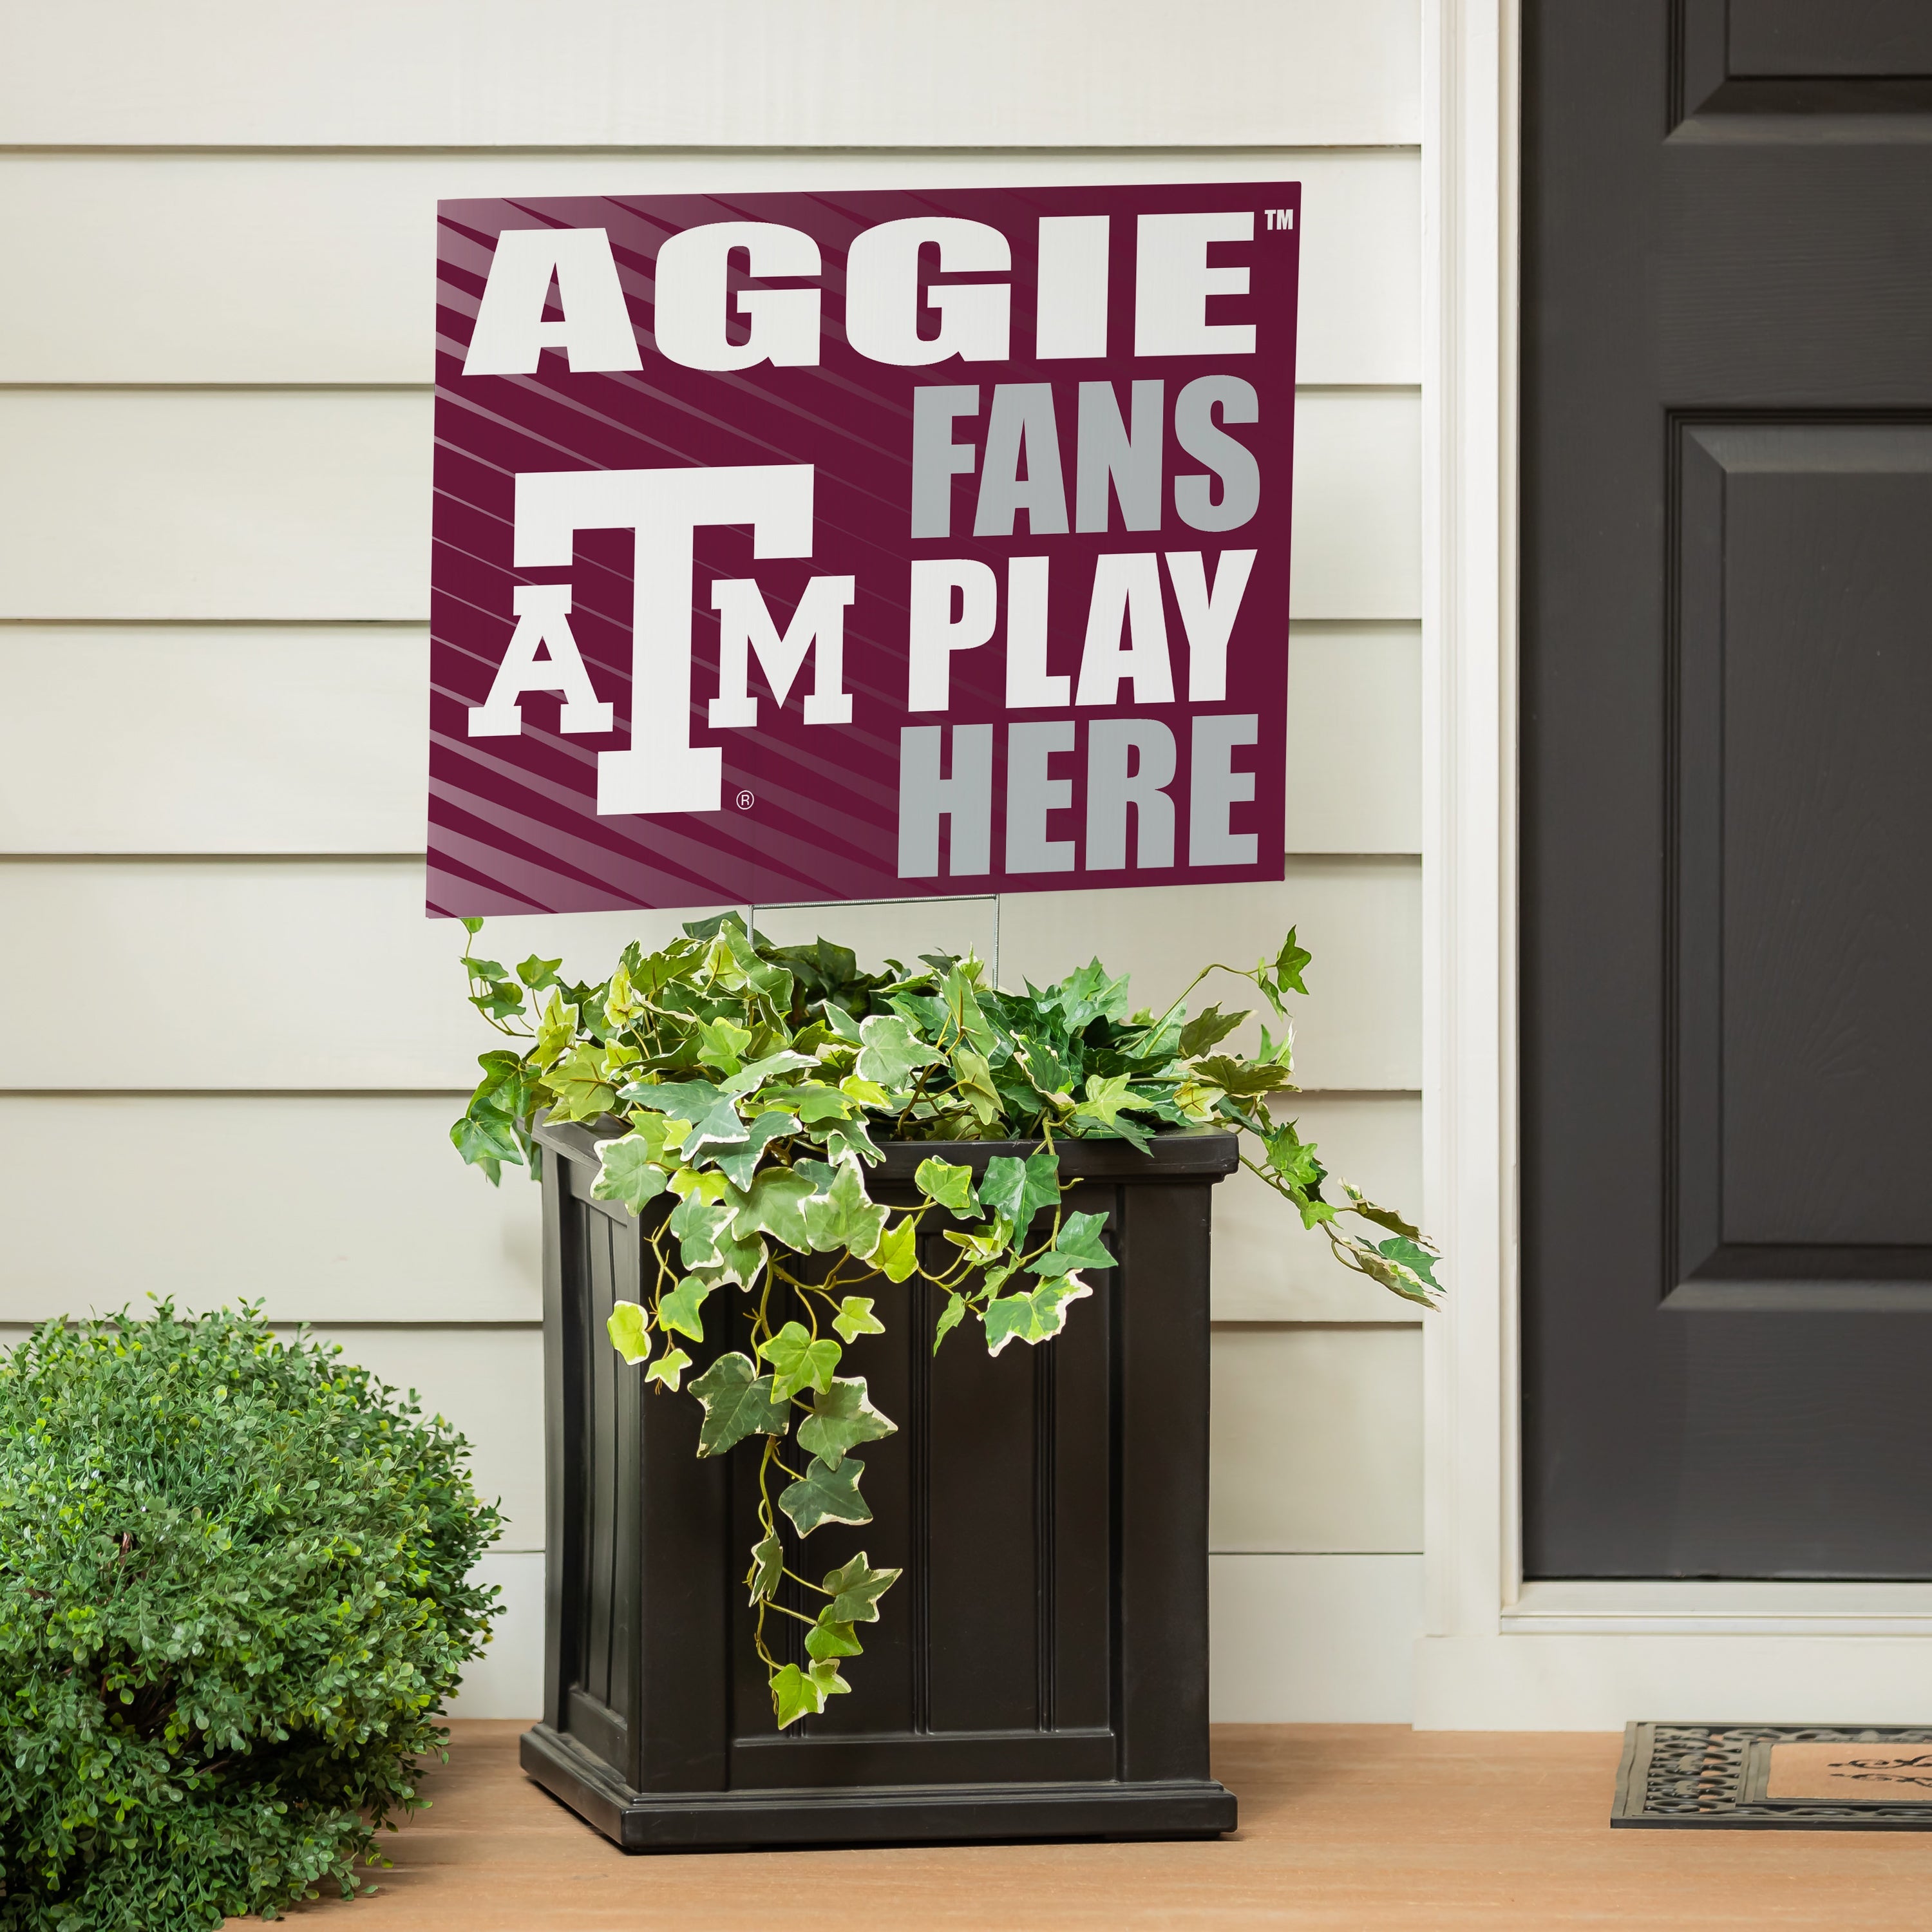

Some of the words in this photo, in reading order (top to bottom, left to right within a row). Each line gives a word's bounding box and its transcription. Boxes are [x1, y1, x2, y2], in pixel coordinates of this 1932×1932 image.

[462, 212, 1256, 376] AGGIE
[1264, 209, 1294, 231] TM
[911, 374, 1260, 539] FANS
[908, 549, 1258, 712] PLAY
[897, 714, 1258, 878] HERE
